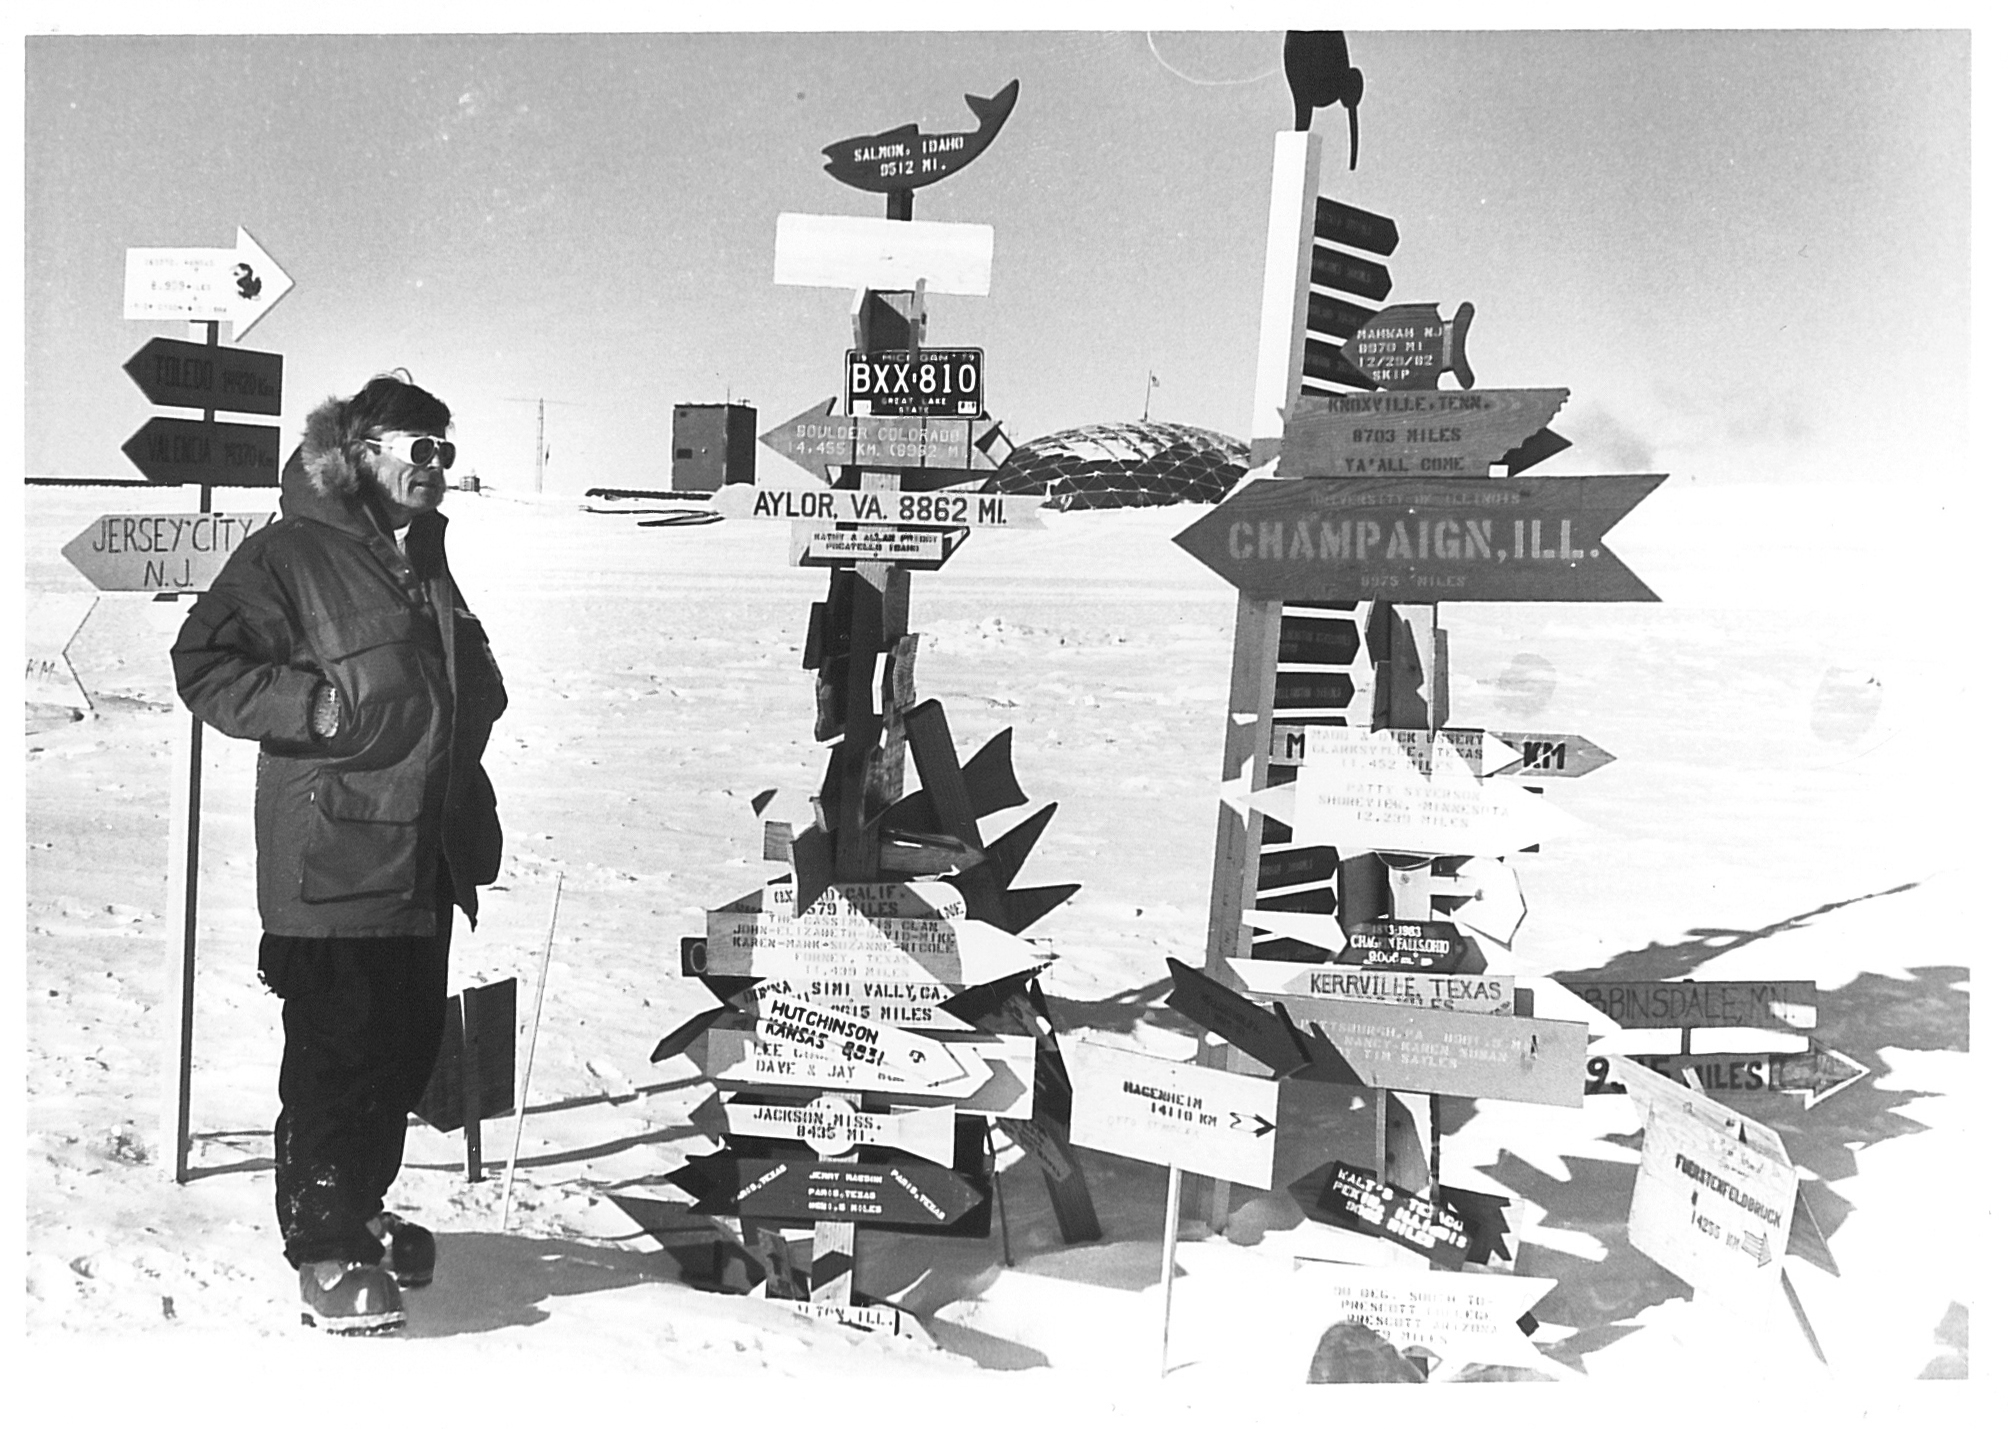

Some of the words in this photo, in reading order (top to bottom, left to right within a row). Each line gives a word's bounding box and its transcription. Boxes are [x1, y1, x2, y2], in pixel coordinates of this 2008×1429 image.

[922, 136, 964, 155] IDAHO
[922, 157, 947, 173] MI.
[1424, 327, 1443, 338] NJ
[1405, 341, 1423, 352] MI
[154, 353, 214, 393] TOLEDO
[1372, 369, 1411, 382] SKIP
[881, 397, 914, 406] GREAT
[922, 397, 947, 406] LAKE
[796, 424, 868, 441] BOULDER
[877, 426, 962, 445] COLORADO
[1353, 429, 1395, 444] 8703
[1407, 427, 1462, 443] MILES
[147, 432, 212, 464] VALENCIA
[788, 440, 846, 455] 14,455
[1345, 458, 1409, 473] YA'ALL
[1420, 456, 1466, 472] COME
[753, 490, 839, 519] AYLOR,
[850, 493, 888, 520] VA.
[899, 495, 969, 523] 8862
[977, 497, 1007, 525] MI.
[1309, 492, 1402, 506] UNIVERSITY
[1414, 493, 1433, 504] OF
[1444, 492, 1521, 505] ILLINOIS
[193, 517, 253, 553] CITY
[1361, 574, 1400, 588] 8975
[1416, 574, 1467, 588] MILES
[1379, 731, 1417, 748] DICK
[1434, 752, 1484, 766] TEXAS
[1522, 740, 1567, 770] KM
[1346, 782, 1396, 795] PATTY
[1420, 815, 1471, 829] MILES
[847, 900, 899, 918] MILES
[900, 918, 940, 933] CLAN
[811, 981, 850, 997] SIMI
[1428, 978, 1502, 1001] TEXAS
[880, 1005, 934, 1022] MILES
[1584, 986, 1744, 1024] BBINSDALE,
[770, 998, 881, 1046] HUTCHINSON
[764, 1016, 830, 1050] KANSAS
[755, 1058, 797, 1076] DAVE
[826, 1065, 856, 1079] JAY
[833, 1113, 882, 1132] MISS.
[1150, 1101, 1194, 1122] 14110
[1198, 1112, 1218, 1128] KM
[796, 1124, 837, 1140] 8435
[846, 1127, 877, 1143] MI.
[808, 1170, 841, 1182] JERRY
[849, 1203, 884, 1215] MILES
[1340, 1299, 1417, 1315] PRESCOTT
[1346, 1313, 1421, 1330] PRESCOTT
